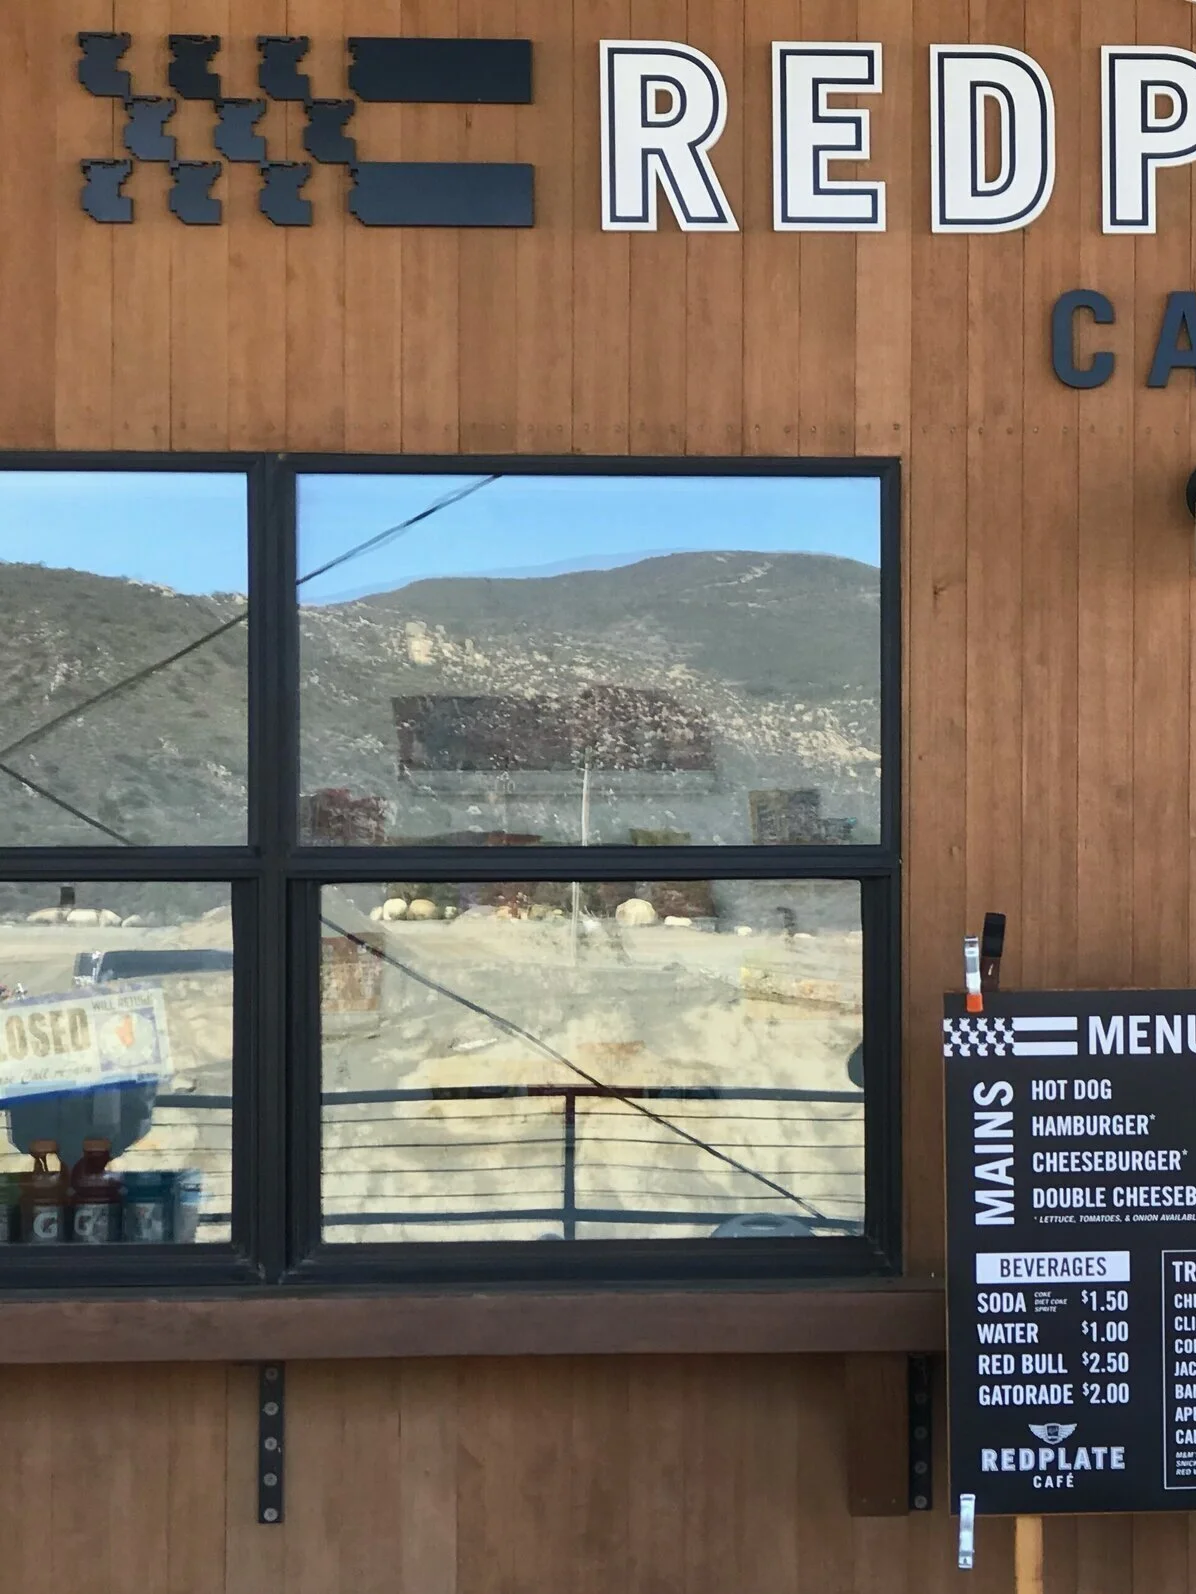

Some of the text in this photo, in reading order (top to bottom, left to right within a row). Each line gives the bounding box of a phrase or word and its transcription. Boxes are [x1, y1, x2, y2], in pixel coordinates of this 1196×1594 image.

[0, 1007, 92, 1062] OSED
[1032, 1079, 1111, 1100] HOT DOG
[974, 1081, 1014, 1225] MAINS
[1033, 1188, 1106, 1208] DOUBLE
[1040, 1215, 1076, 1224] LETTUCE,
[1080, 1214, 1122, 1223] TOMATOES,
[1125, 1214, 1130, 1223] &
[1133, 1213, 1158, 1222] ONION
[1001, 1257, 1106, 1277] BEVERAGES
[978, 1292, 1026, 1313] SODA
[1082, 1290, 1128, 1311] $1.50
[977, 1323, 1038, 1343] WATER
[1082, 1321, 1128, 1342] $1.00
[979, 1354, 1067, 1374] RED BULL
[1082, 1352, 1128, 1372] $2.50
[979, 1384, 1073, 1405] GATORADE
[1083, 1382, 1129, 1403] $2.00
[982, 1447, 1125, 1471] REDPLATE
[1033, 1473, 1073, 1488] CAFÉ
[1176, 1468, 1191, 1476] RED
